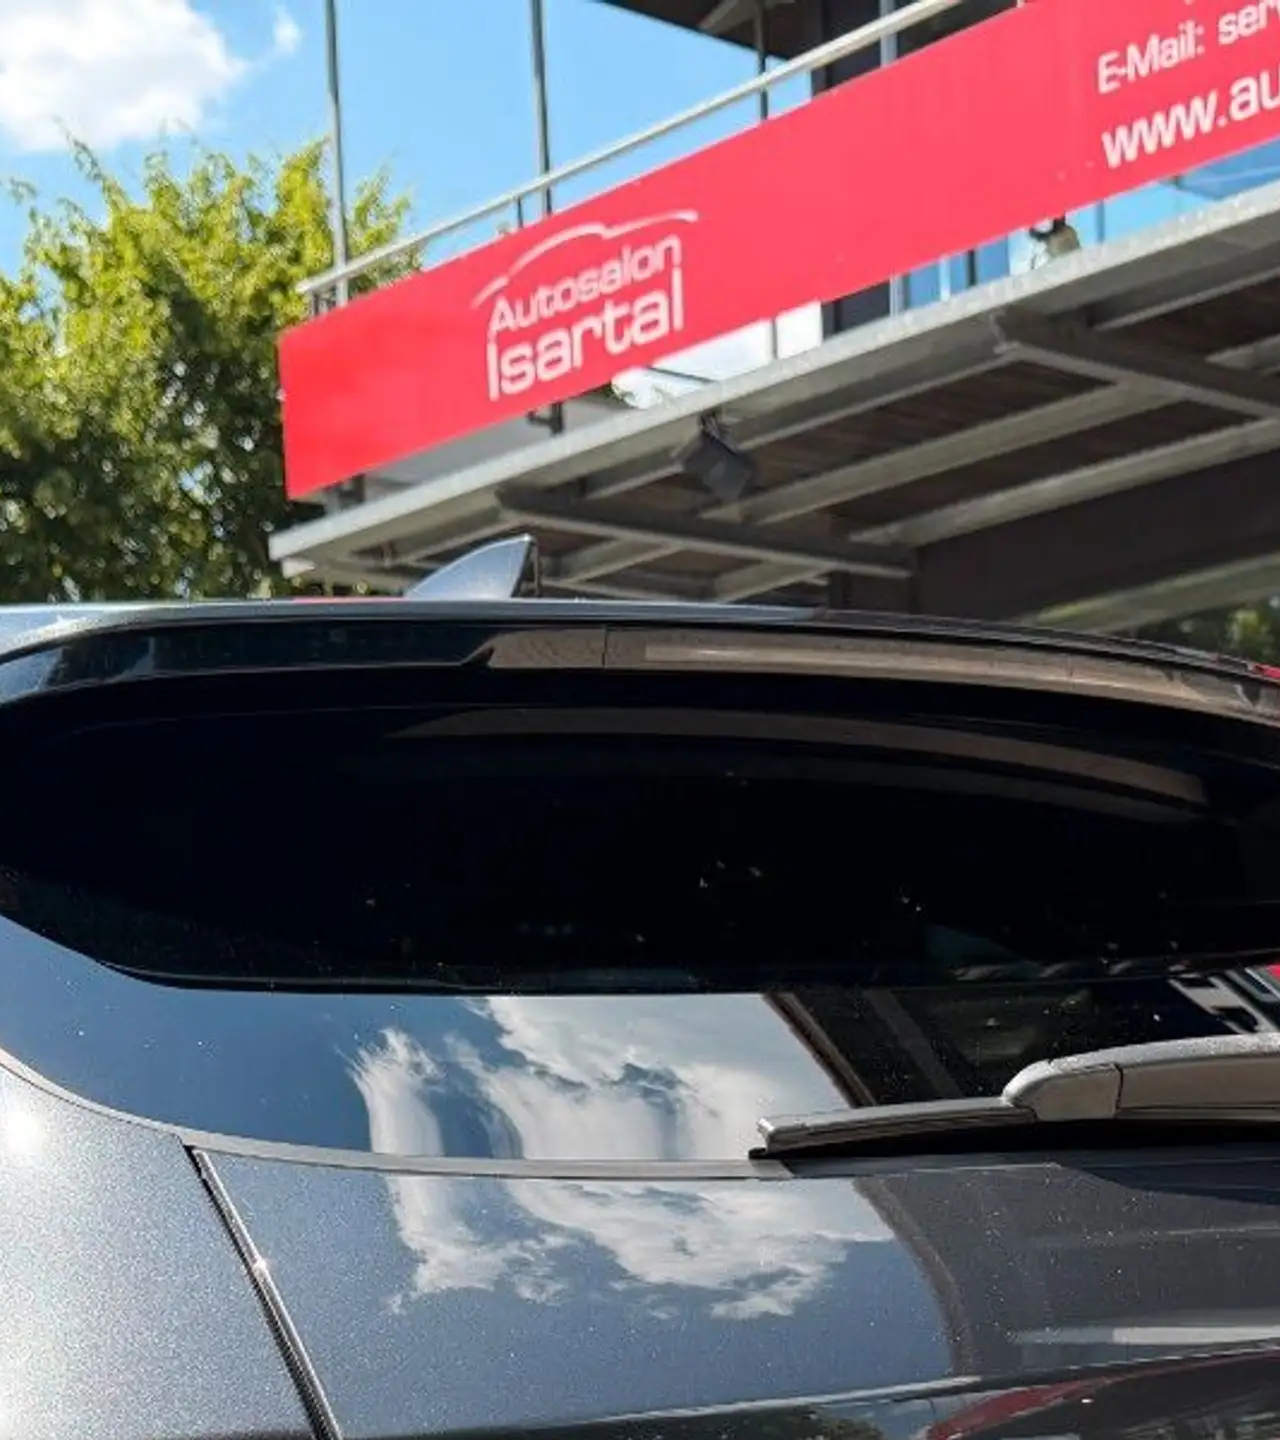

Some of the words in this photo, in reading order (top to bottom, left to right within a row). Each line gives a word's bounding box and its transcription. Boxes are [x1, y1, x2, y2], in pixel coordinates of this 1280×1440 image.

[1097, 22, 1206, 95] E-Mail:
[487, 266, 684, 401] Isartal
[488, 235, 682, 340] Autosalon
